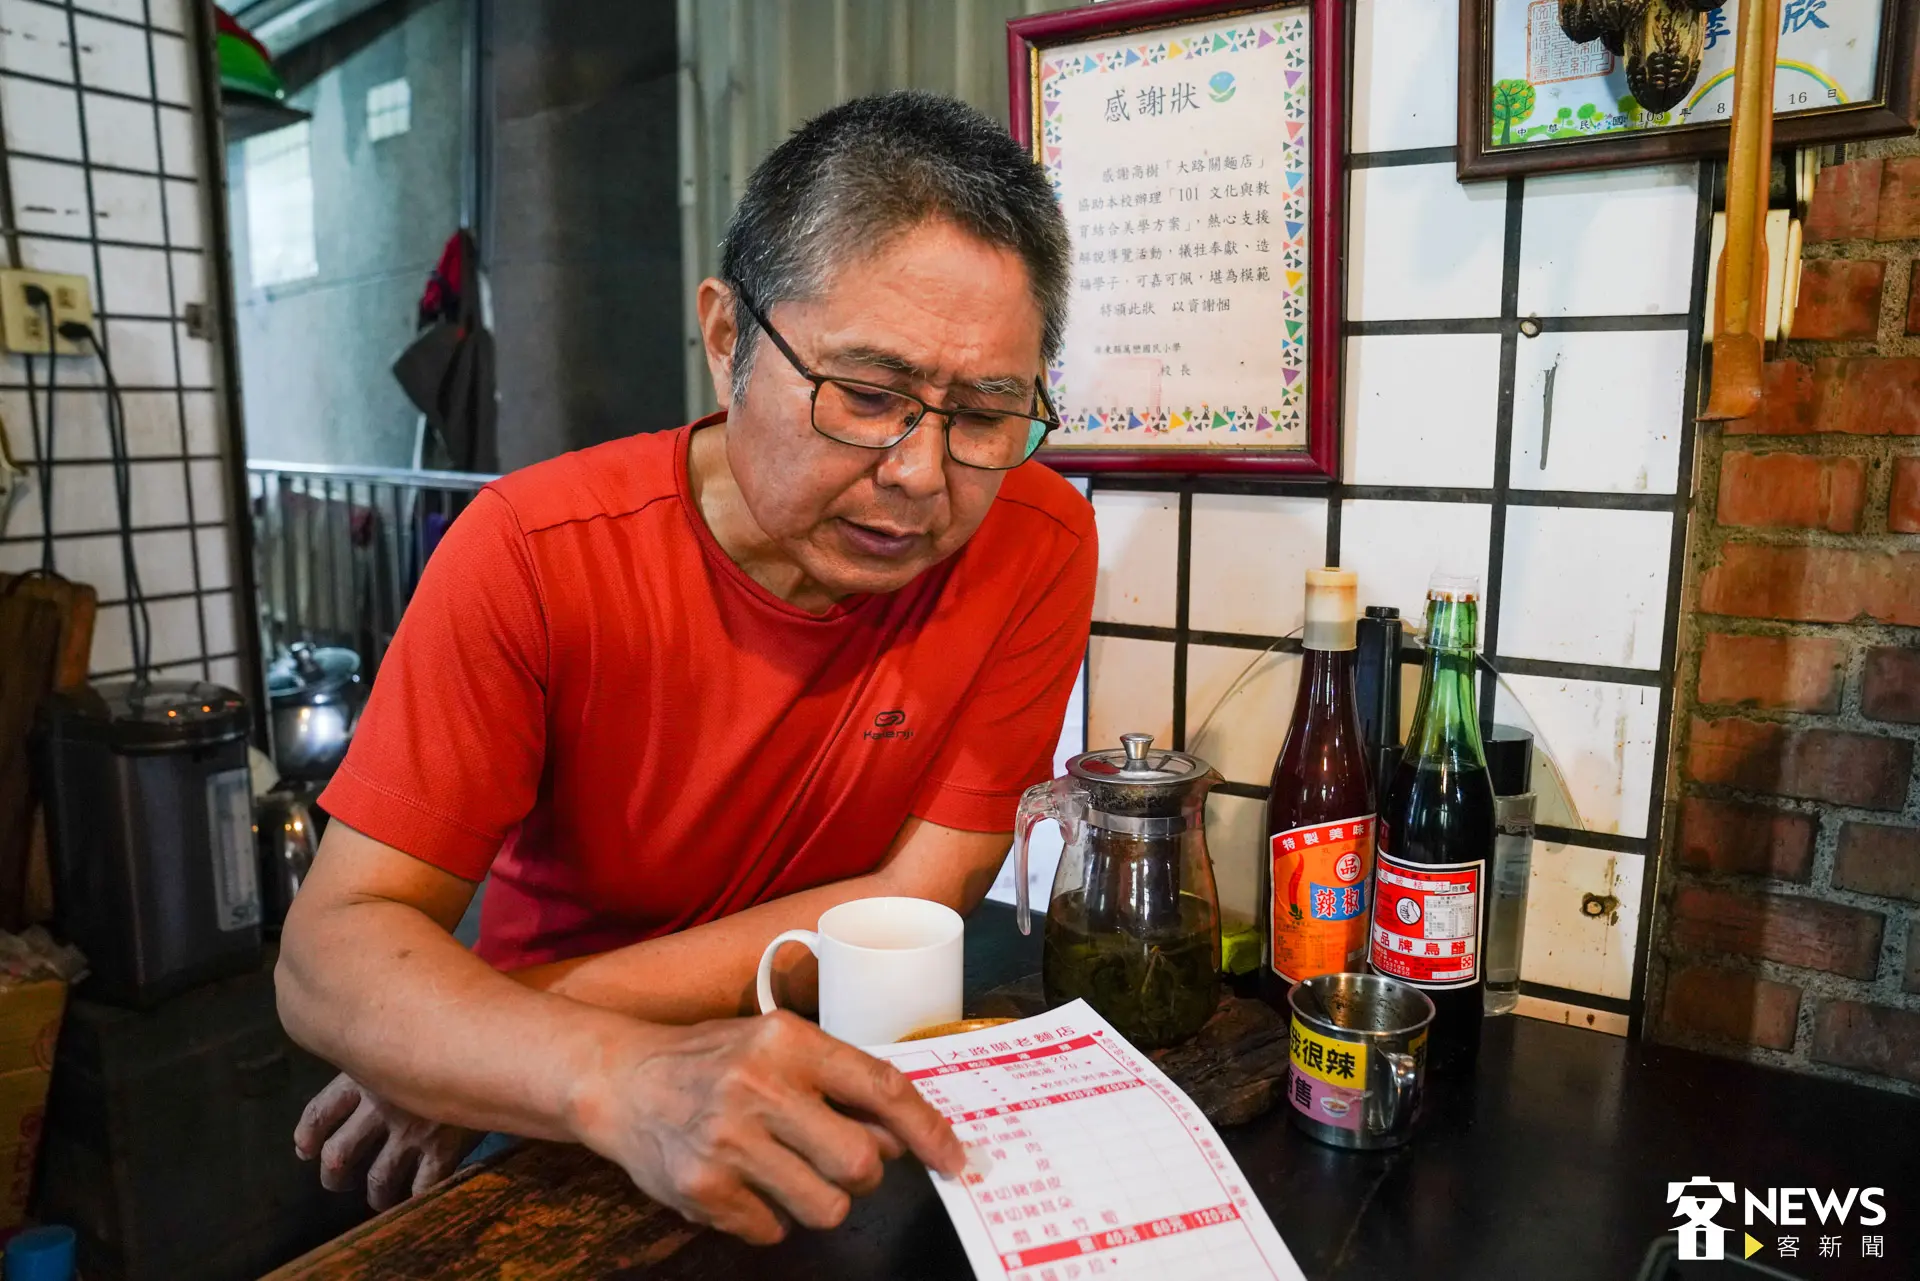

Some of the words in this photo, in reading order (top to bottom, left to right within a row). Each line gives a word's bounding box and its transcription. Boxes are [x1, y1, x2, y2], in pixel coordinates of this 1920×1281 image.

[1104, 82, 1201, 124] 感謝狀
[1282, 824, 1364, 851] 特製美味
[1315, 888, 1360, 918] 辣椒
